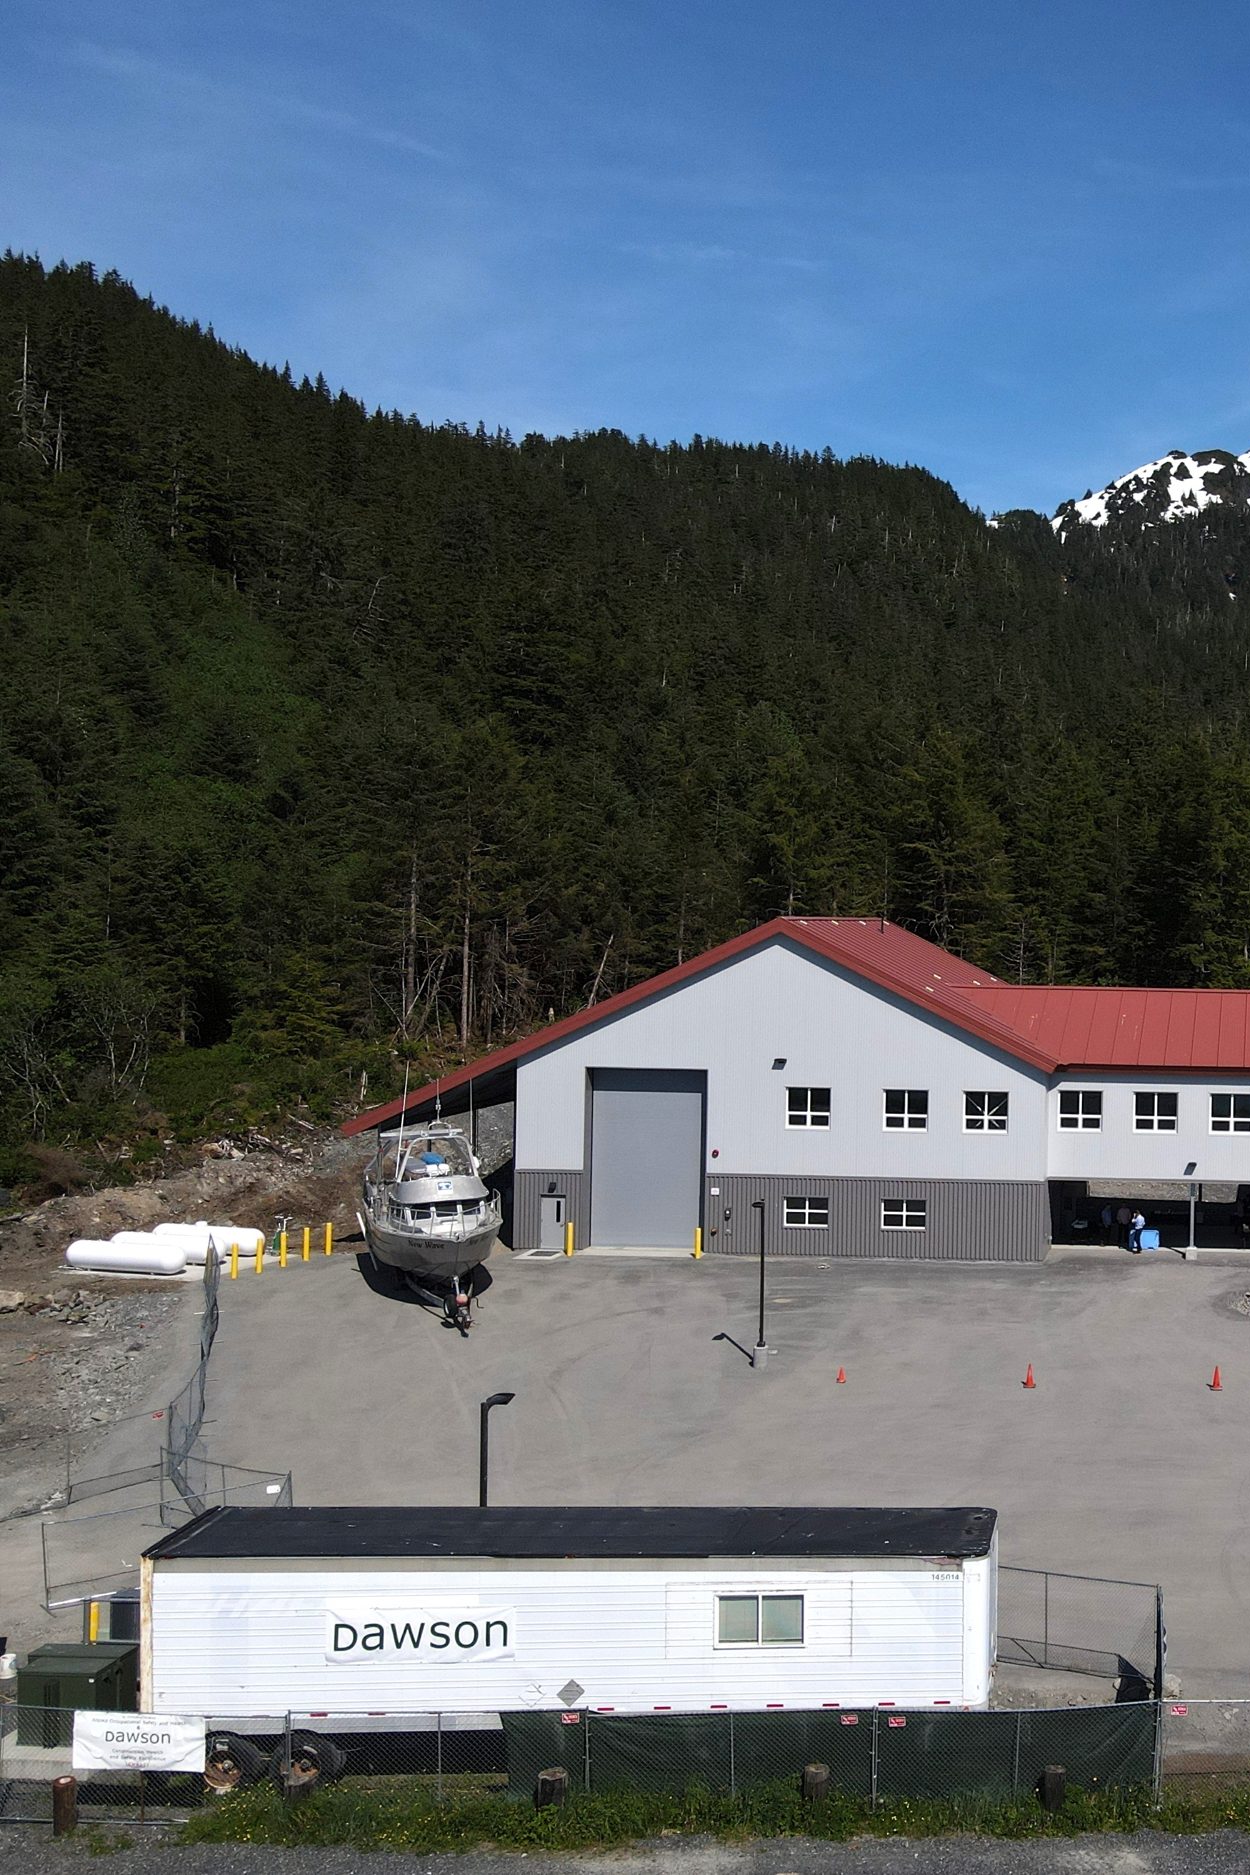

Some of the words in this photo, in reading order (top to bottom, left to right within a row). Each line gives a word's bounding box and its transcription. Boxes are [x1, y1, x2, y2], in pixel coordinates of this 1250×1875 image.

[408, 1239, 423, 1248] New
[425, 1241, 445, 1249] Wave
[333, 1618, 509, 1652] Dawson
[105, 1730, 171, 1744] Dawson
